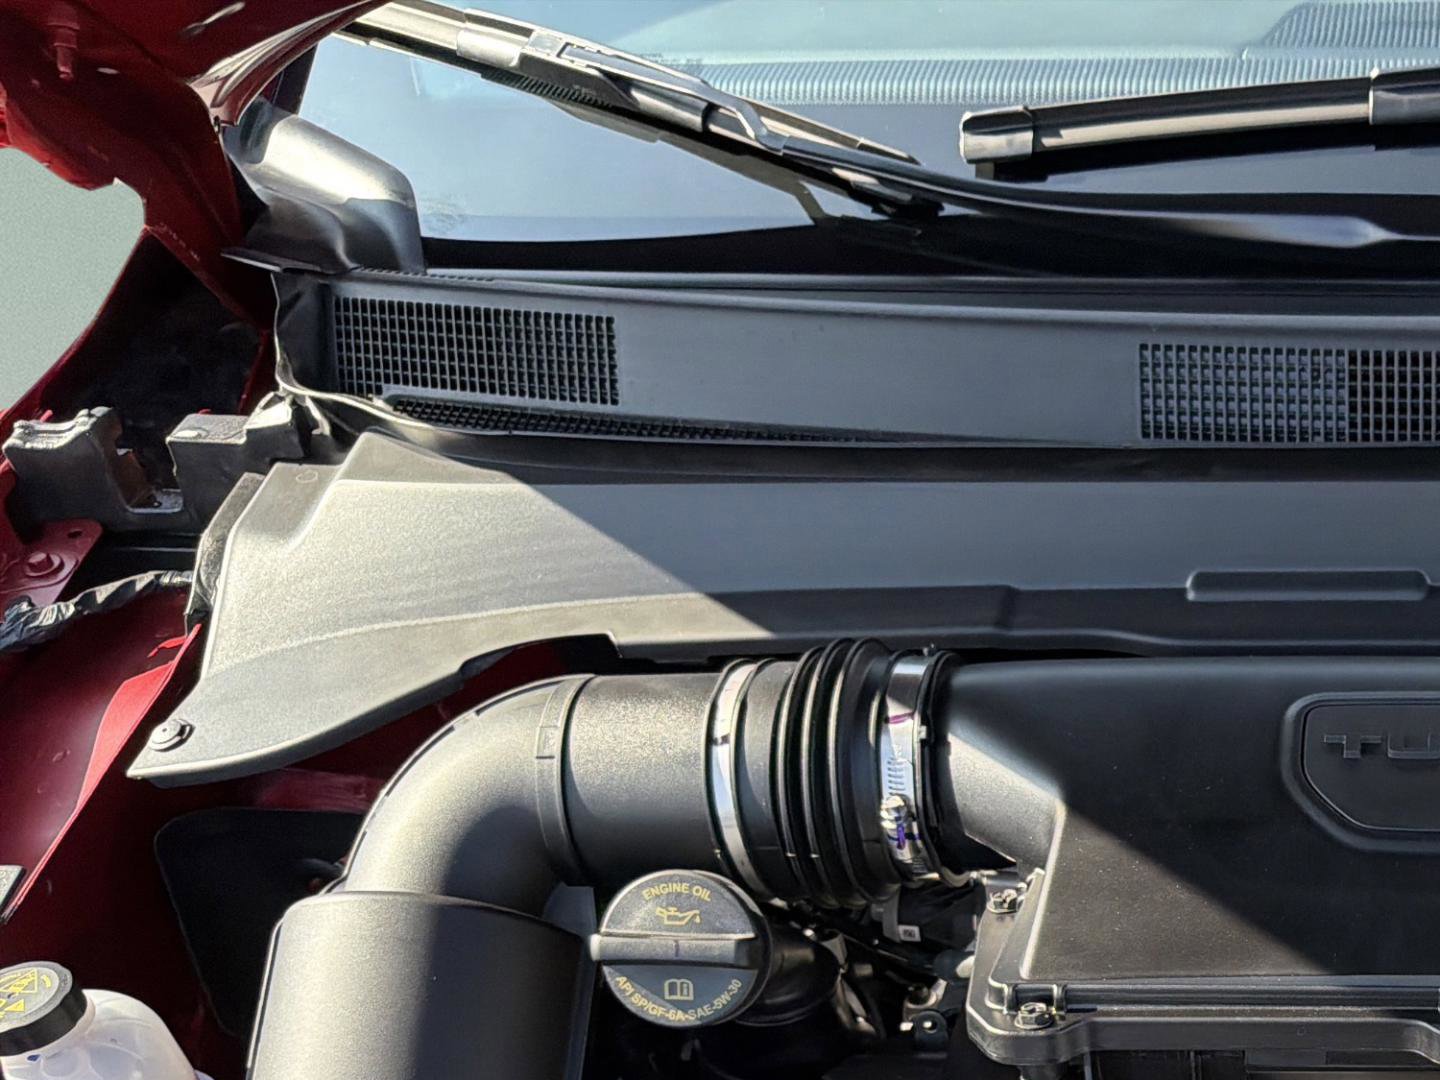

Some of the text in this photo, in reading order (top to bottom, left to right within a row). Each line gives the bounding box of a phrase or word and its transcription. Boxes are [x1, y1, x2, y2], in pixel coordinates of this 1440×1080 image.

[642, 882, 713, 902] ENGINE OIL
[615, 975, 635, 995] API
